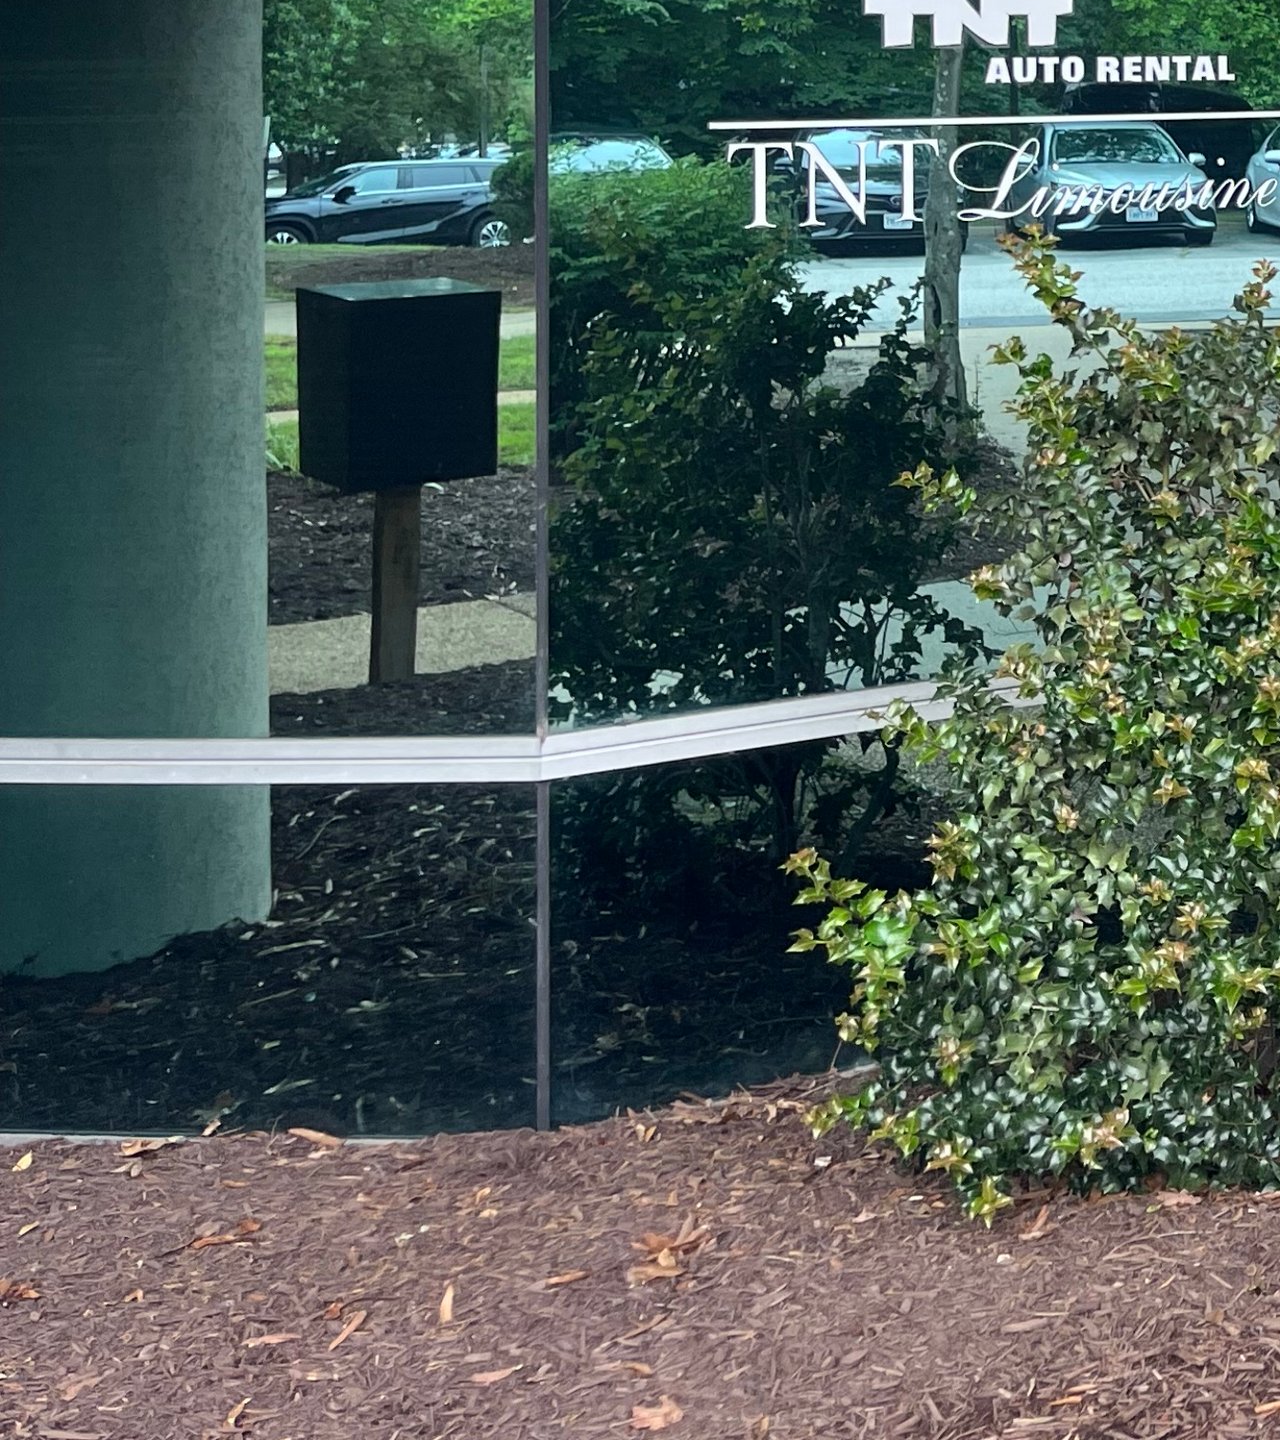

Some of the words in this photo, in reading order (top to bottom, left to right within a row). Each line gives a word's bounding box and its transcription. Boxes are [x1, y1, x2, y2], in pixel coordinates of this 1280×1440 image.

[985, 56, 1085, 85] AUTO
[1096, 54, 1236, 83] RENTAL
[726, 138, 940, 231] TNT
[948, 136, 1279, 223] Limousine
